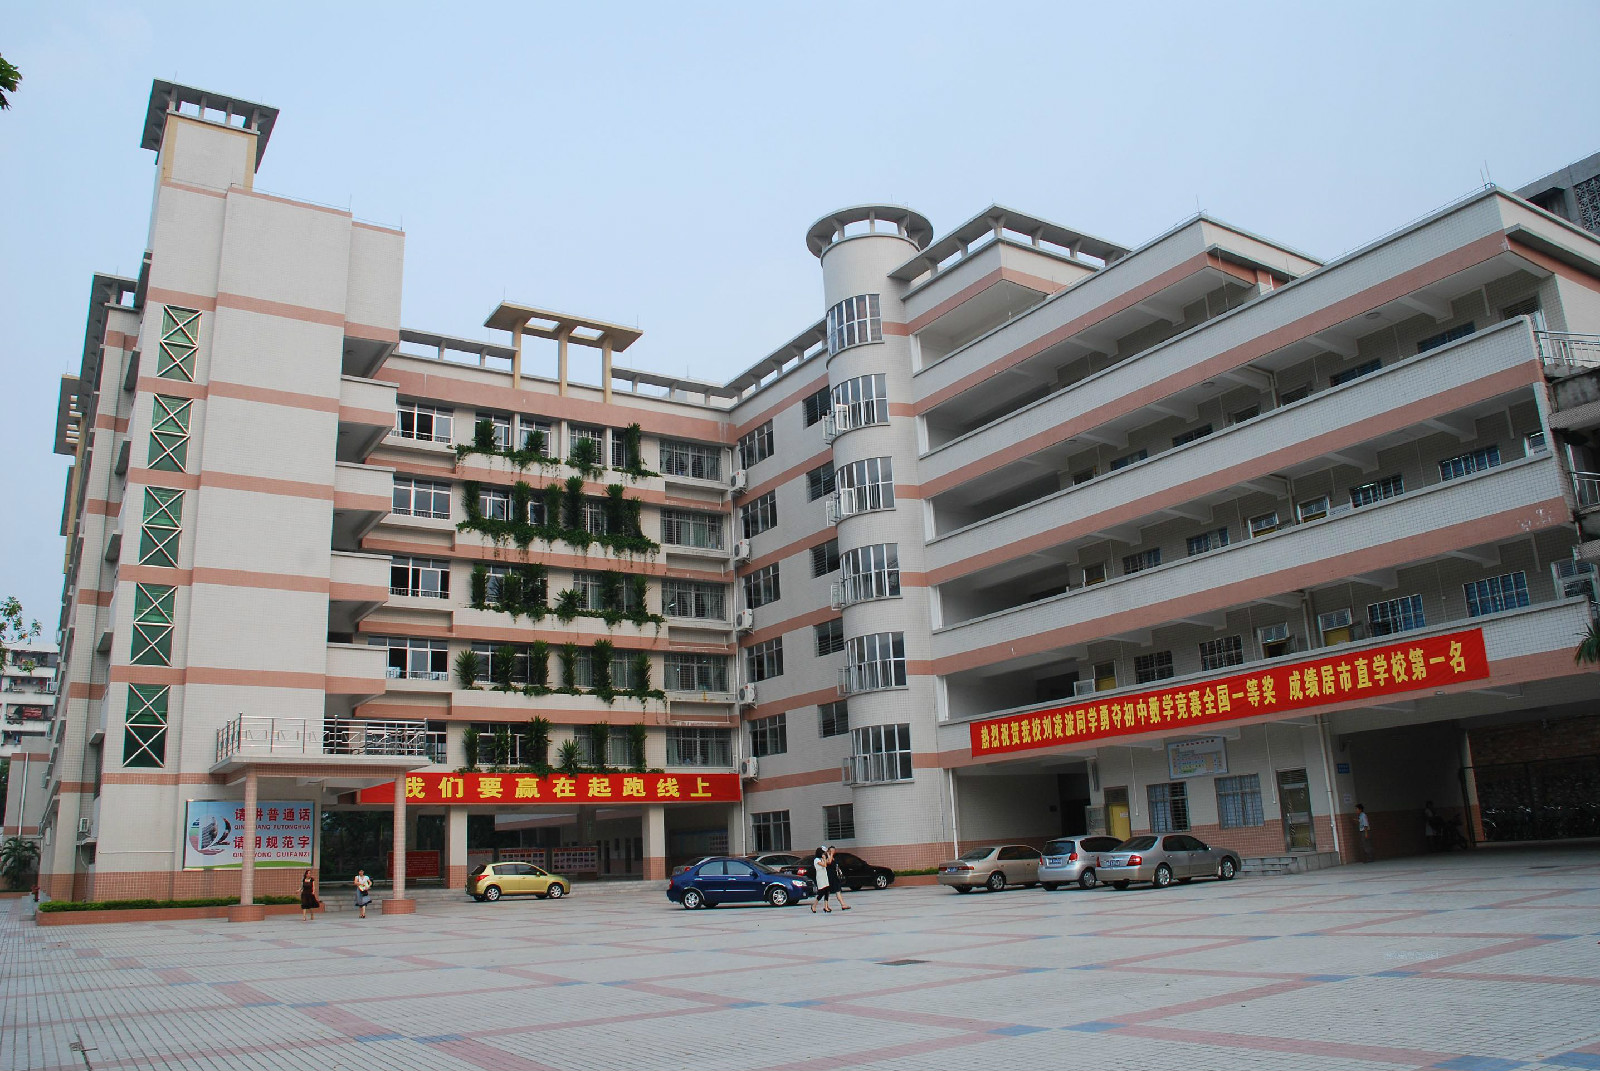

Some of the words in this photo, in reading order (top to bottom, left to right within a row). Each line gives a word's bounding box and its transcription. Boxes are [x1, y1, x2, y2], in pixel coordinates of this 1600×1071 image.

[1289, 640, 1466, 700] 成绩居市直学校第一名
[405, 776, 712, 799] 我们要赢在起跑线上
